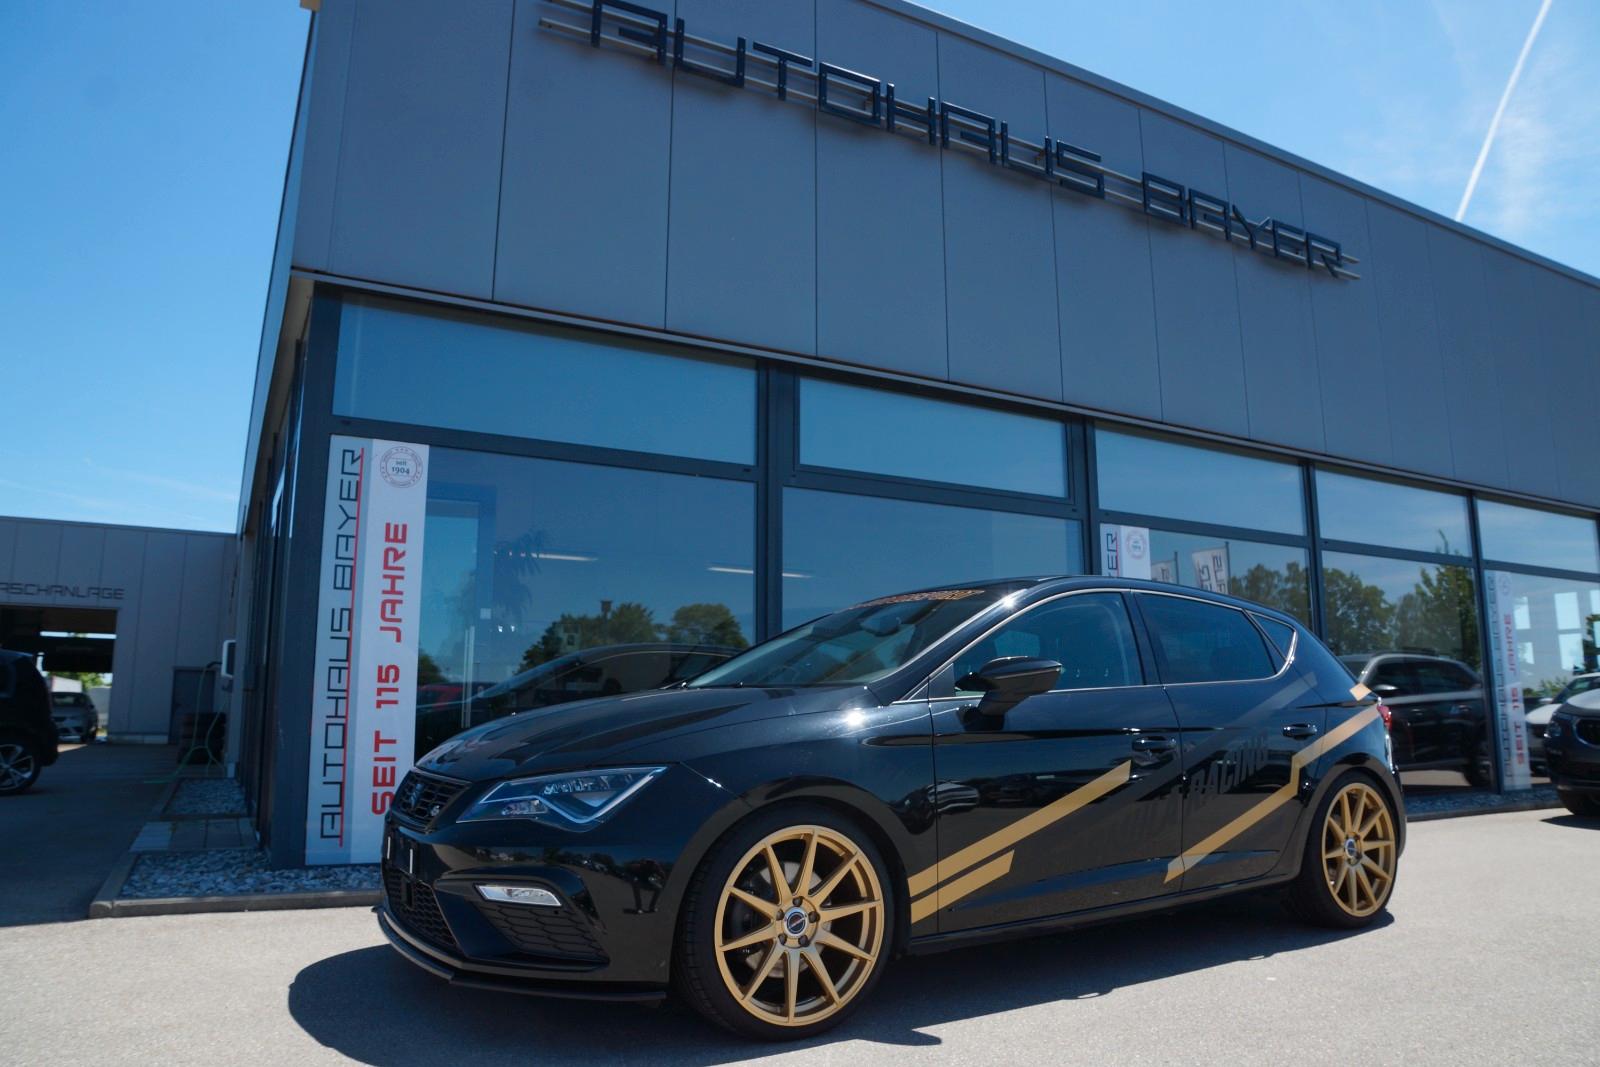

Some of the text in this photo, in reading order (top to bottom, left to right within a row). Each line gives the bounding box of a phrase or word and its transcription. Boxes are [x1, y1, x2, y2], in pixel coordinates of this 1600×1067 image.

[590, 0, 1339, 279] AUTOHAUS BAYER
[320, 449, 362, 839] AUTOHAUS BAYER
[371, 522, 408, 815] SEIT 115 JAHRE
